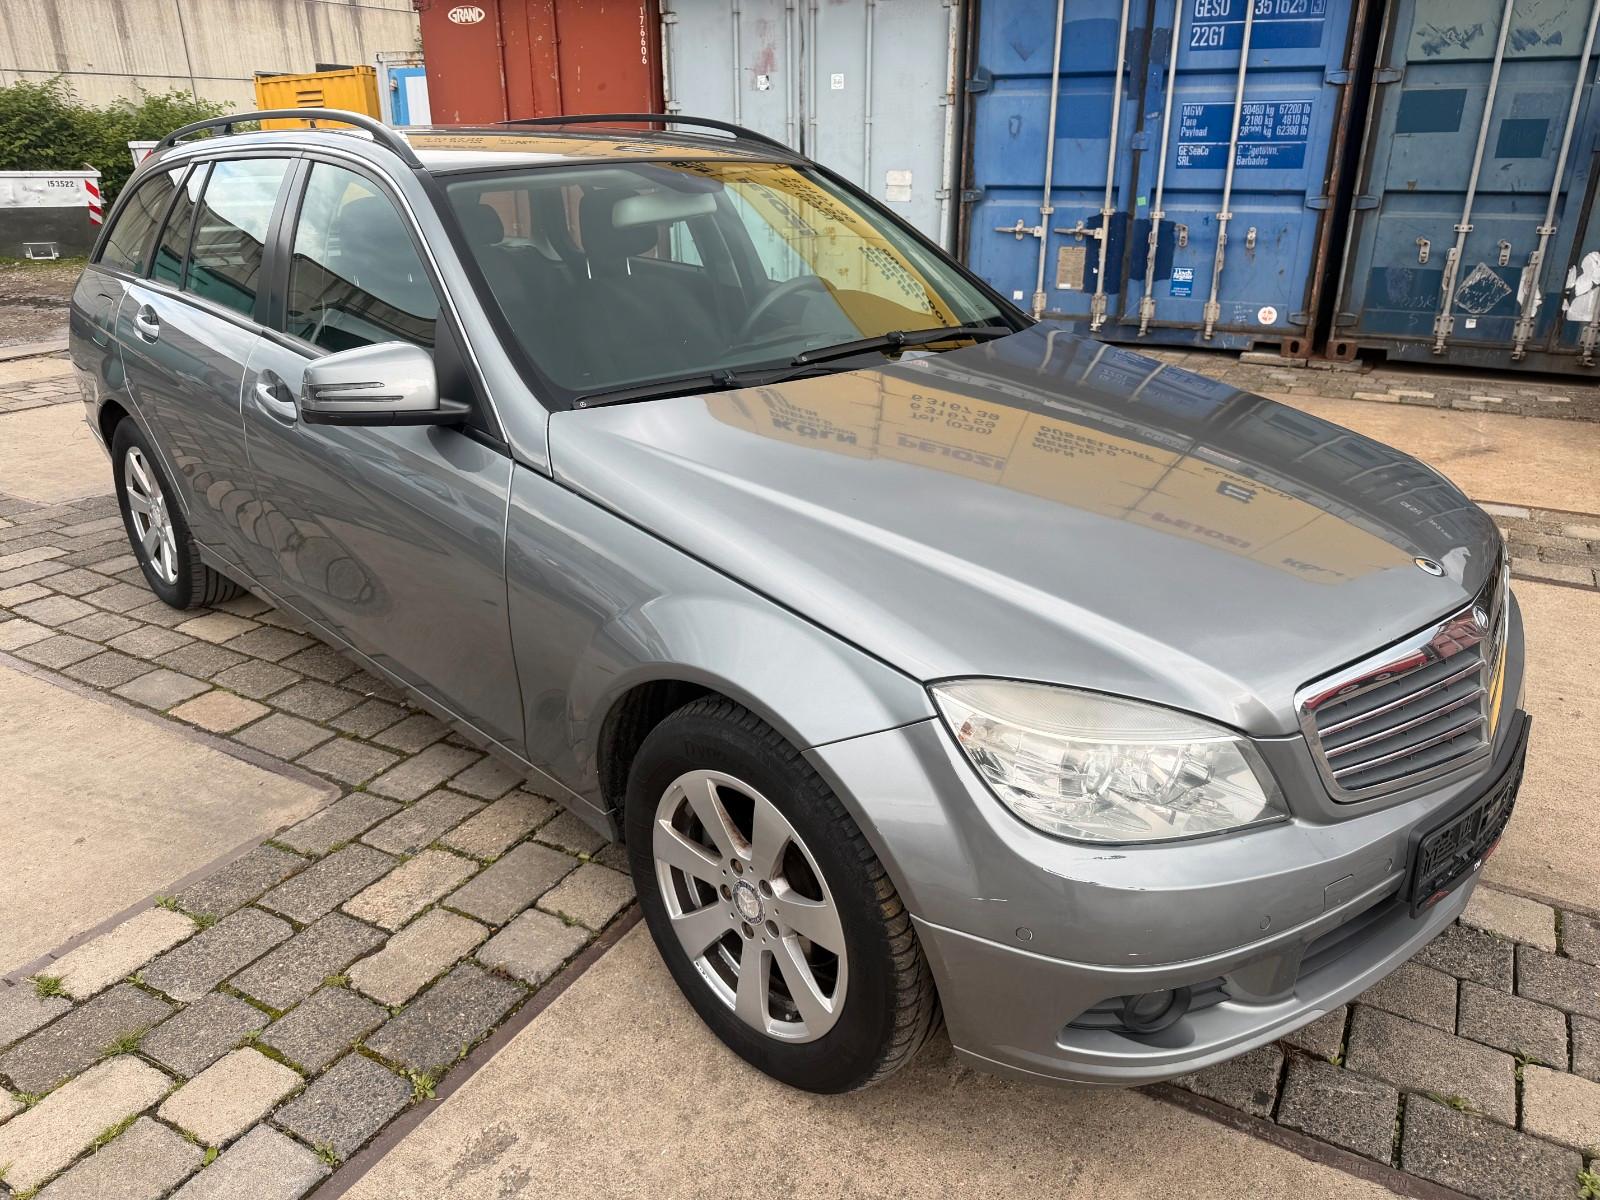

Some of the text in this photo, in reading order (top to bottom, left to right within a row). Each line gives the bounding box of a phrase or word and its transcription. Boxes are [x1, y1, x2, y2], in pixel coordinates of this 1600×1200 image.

[448, 5, 485, 24] GRAND
[1194, 0, 1231, 17] GESU
[1190, 26, 1226, 47] 22G1
[1183, 105, 1204, 116] MGW
[1266, 104, 1275, 116] kg
[1279, 103, 1302, 114] 67200
[1303, 103, 1311, 114] lb
[1183, 116, 1197, 126] Tare
[1264, 115, 1273, 127] kg
[1281, 114, 1301, 125] 4810
[1301, 114, 1309, 125] lb
[1180, 126, 1208, 138] Payload
[1262, 125, 1272, 138] kg
[1276, 125, 1299, 136] 62390
[1300, 125, 1308, 136] lb
[1178, 145, 1188, 156] GE
[1235, 155, 1269, 166] Barbados
[47, 180, 75, 188] 153522
